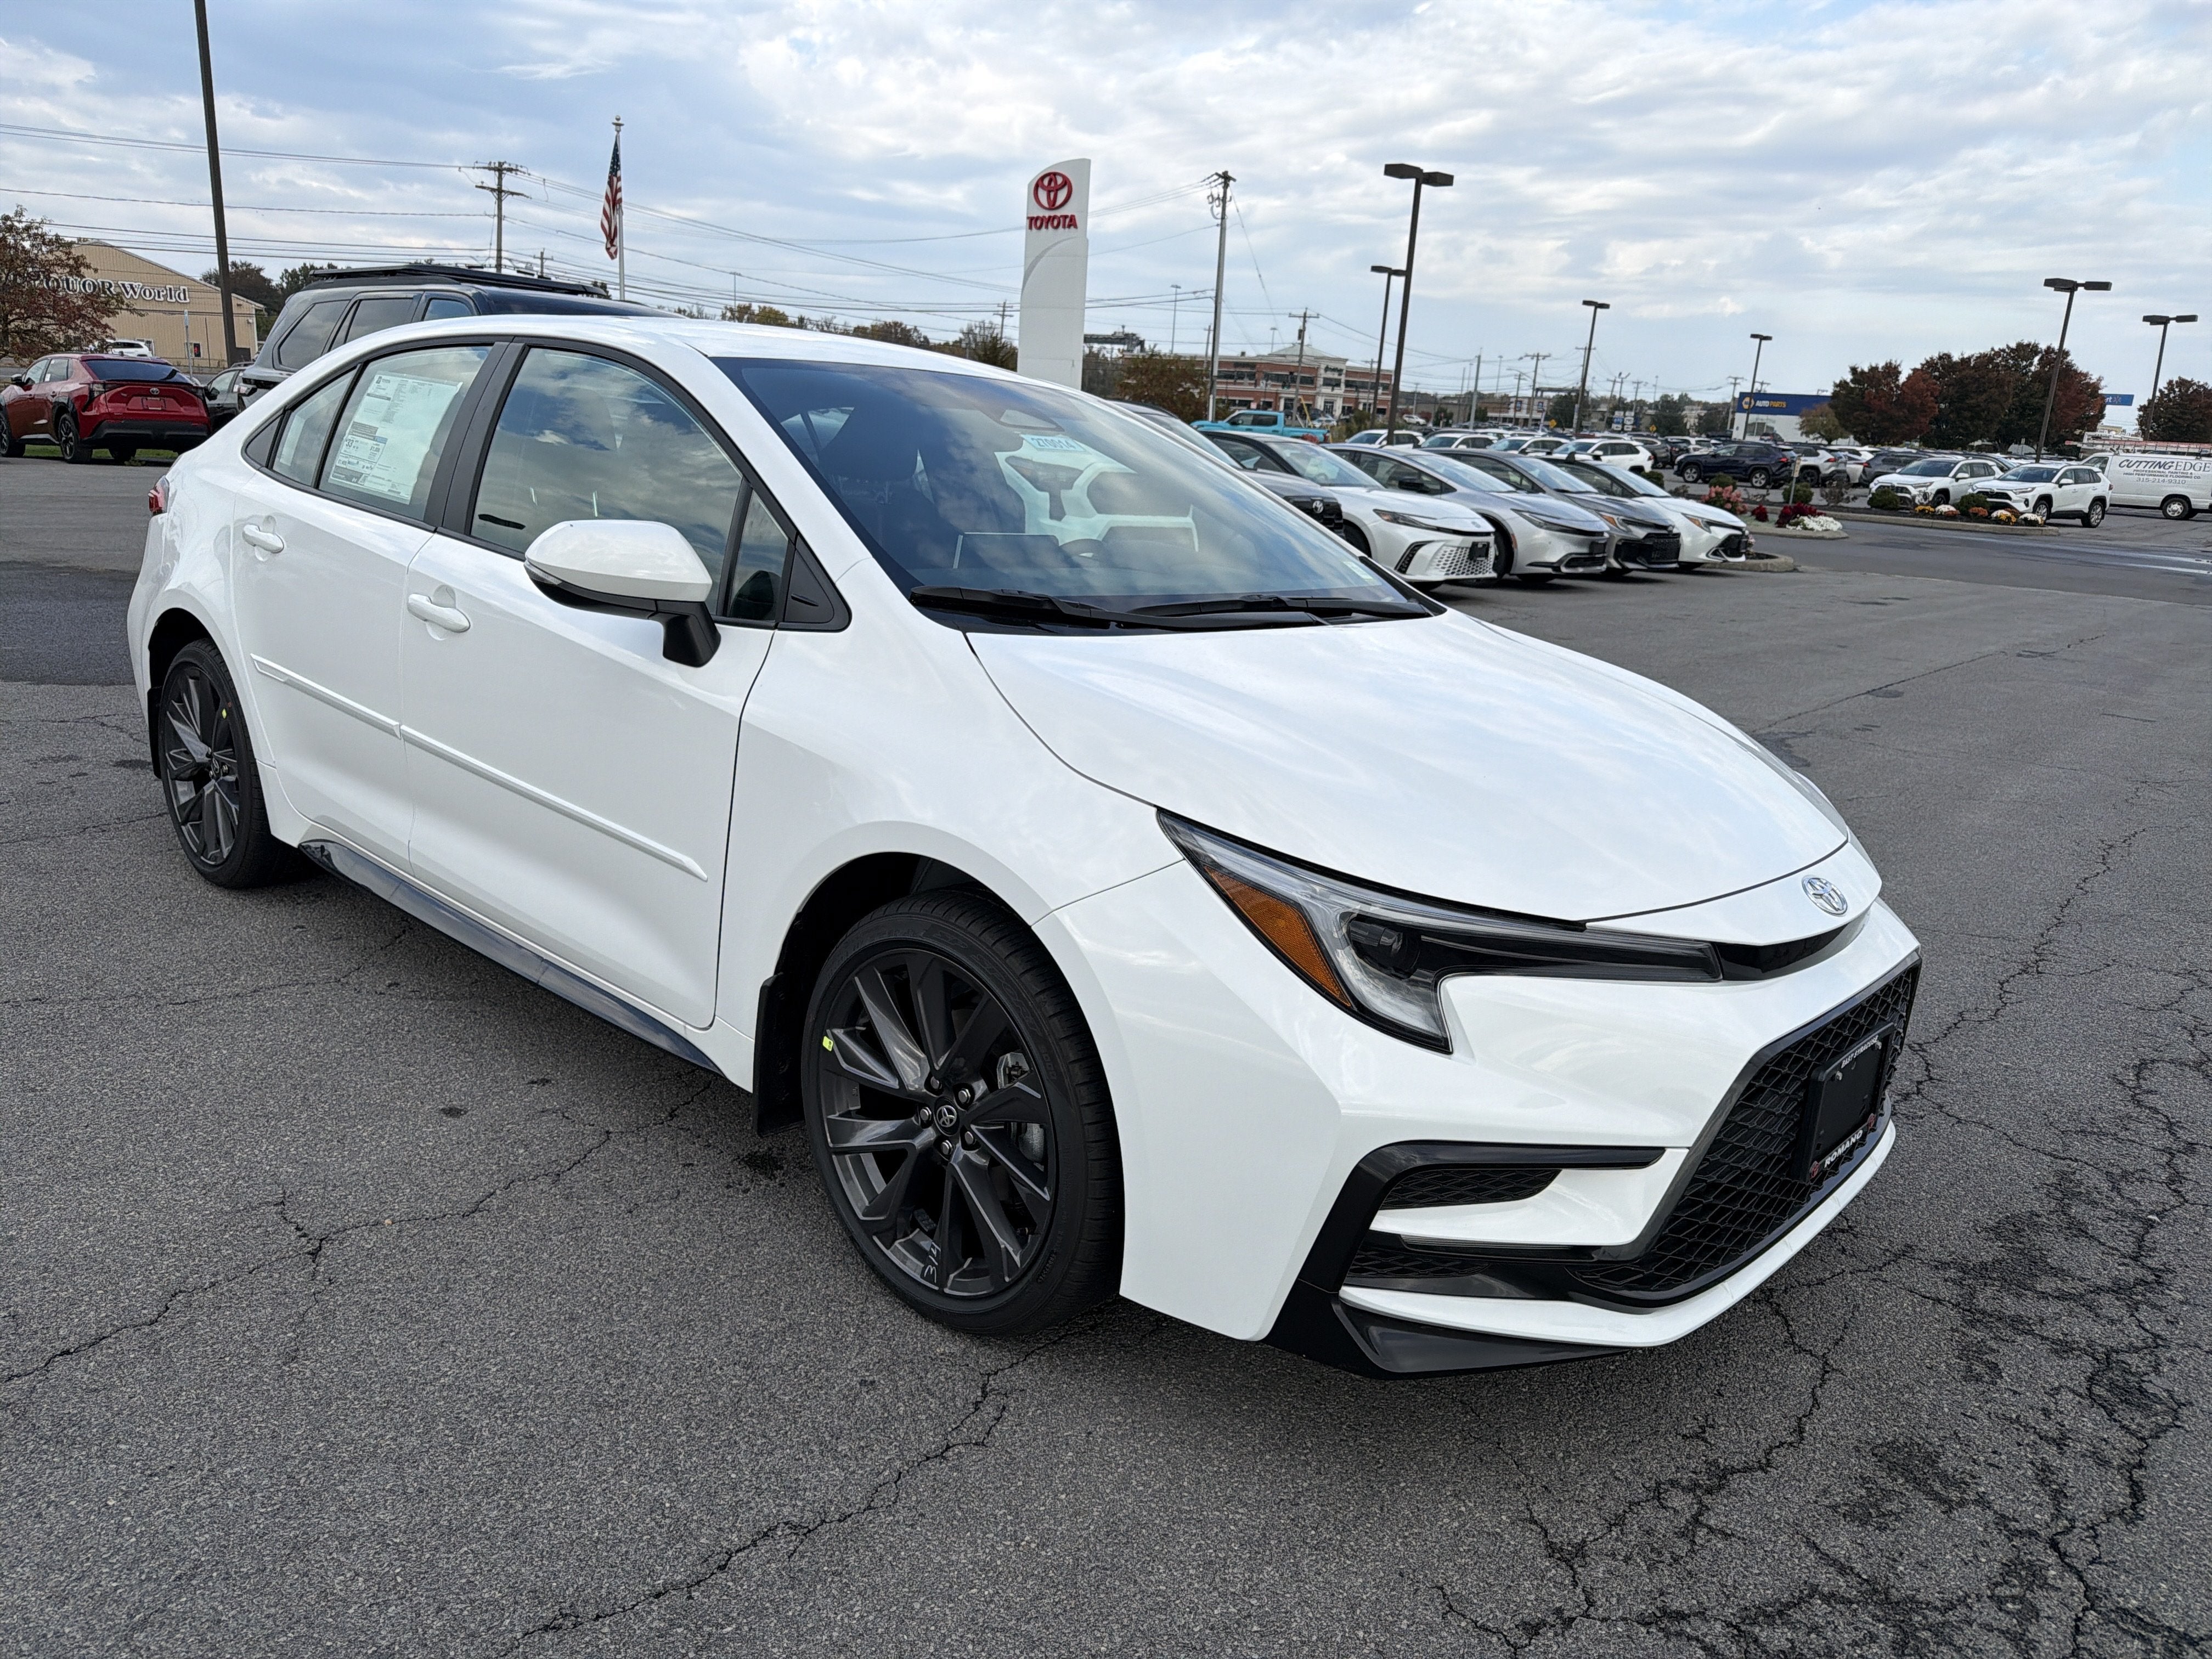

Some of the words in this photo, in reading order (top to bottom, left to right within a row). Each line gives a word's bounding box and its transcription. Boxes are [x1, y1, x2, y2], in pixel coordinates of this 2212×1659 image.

[1027, 215, 1078, 230] TOYOTA
[118, 280, 190, 303] World
[1030, 437, 1077, 450] 270014
[2118, 459, 2175, 470] CUTTING
[2174, 461, 2212, 472] EDGE
[1841, 1053, 1854, 1069] EAST
[1824, 1130, 1863, 1169] ROMANO
